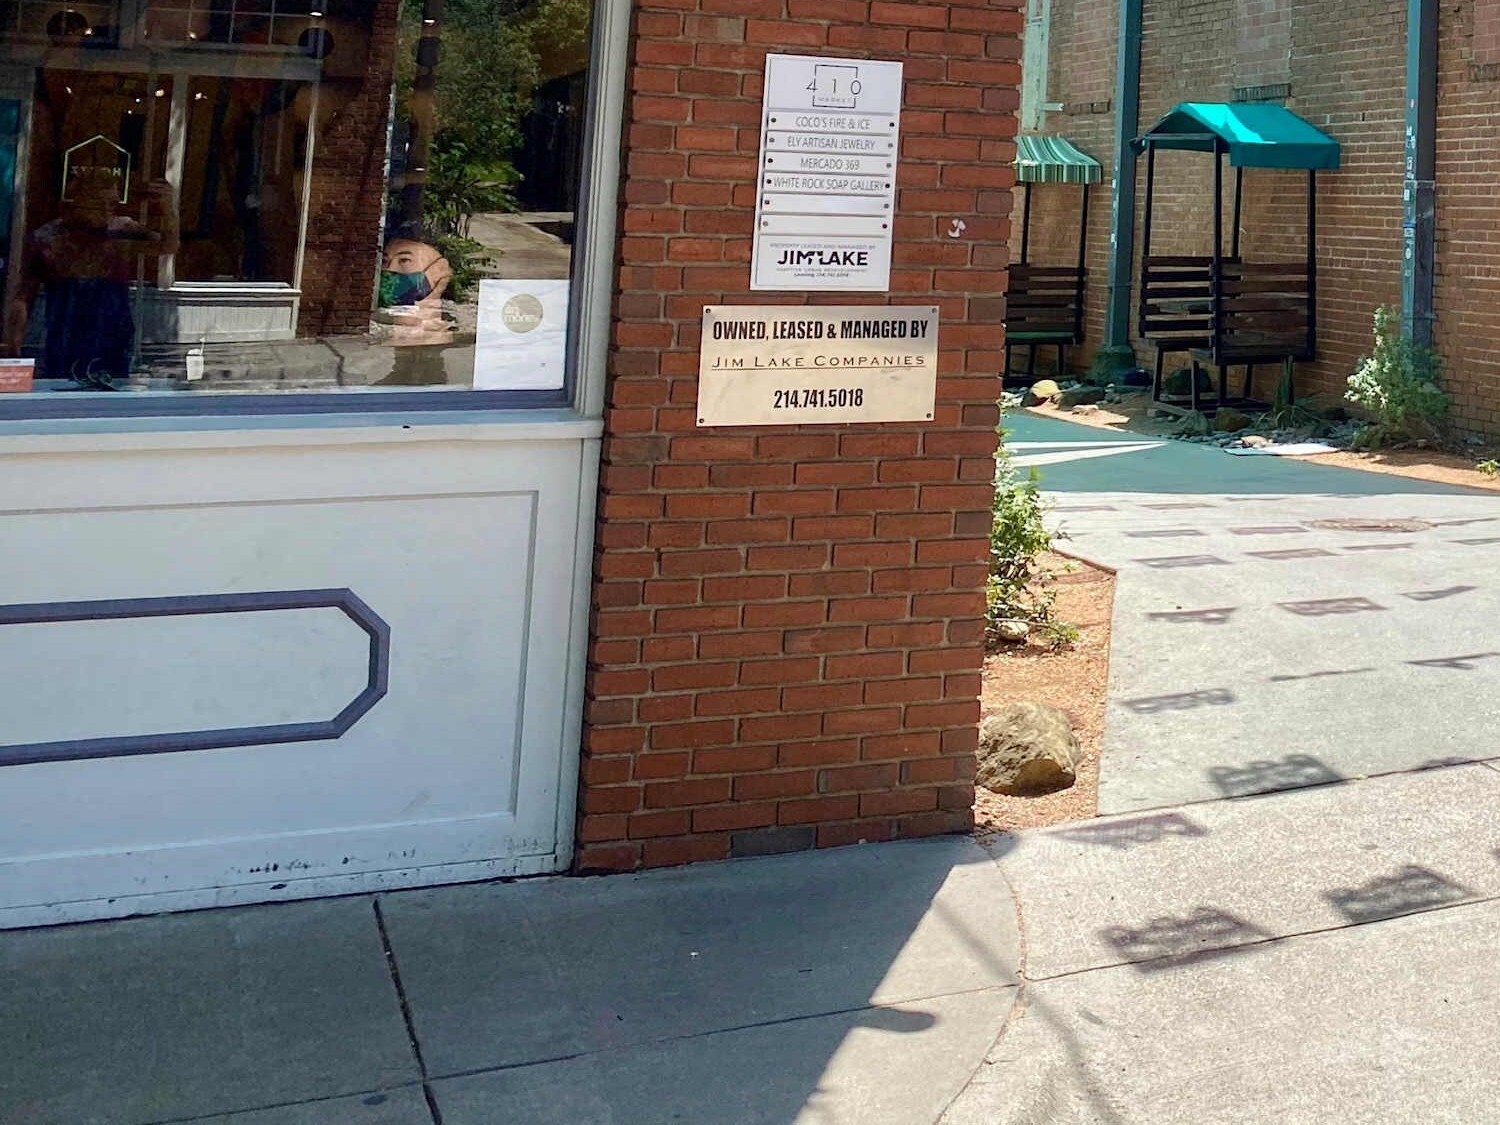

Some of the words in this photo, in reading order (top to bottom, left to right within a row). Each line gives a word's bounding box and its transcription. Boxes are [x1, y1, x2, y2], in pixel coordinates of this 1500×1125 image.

[795, 116, 827, 128] COCO'S
[829, 118, 846, 129] FIRE
[858, 119, 871, 130] ICE
[787, 136, 801, 148] ELY
[802, 137, 837, 149] ARTISAN
[840, 139, 875, 150] JEWELRY
[800, 158, 842, 170] MERCADO
[845, 160, 860, 170] 369
[773, 177, 800, 189] WHITE
[802, 178, 825, 189] ROCK
[827, 179, 848, 190] SOAP
[850, 180, 884, 191] GALLERY
[713, 321, 769, 341] OWNED,
[773, 321, 823, 340] LEASED
[827, 323, 837, 339] &
[841, 320, 906, 339] MANAGED
[911, 320, 928, 338] BY
[774, 388, 863, 409] 214.741.5018
